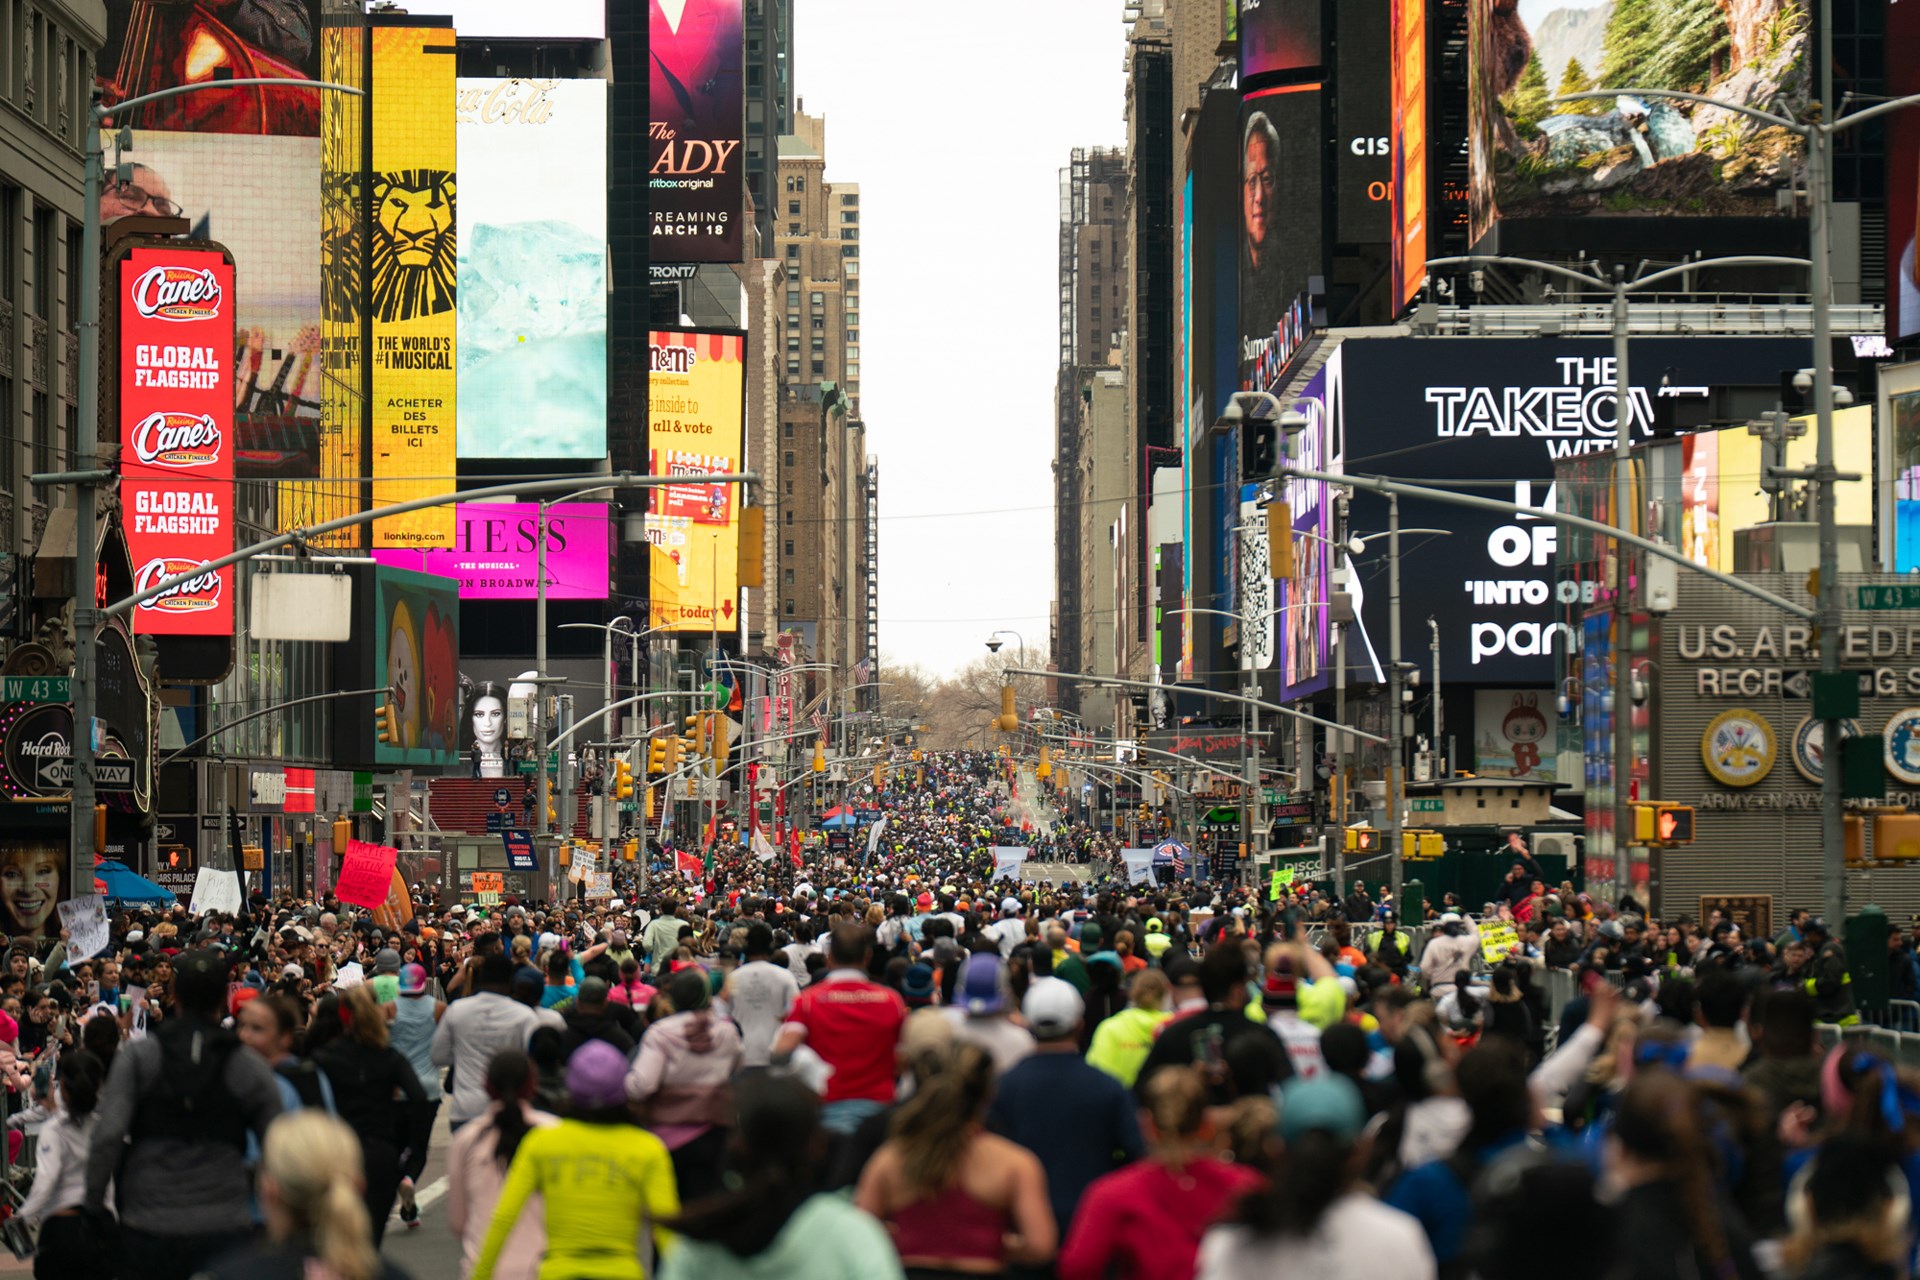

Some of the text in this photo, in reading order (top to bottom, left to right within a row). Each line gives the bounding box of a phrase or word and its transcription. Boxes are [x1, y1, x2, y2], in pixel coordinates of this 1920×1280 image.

[649, 122, 676, 140] The
[678, 178, 714, 190] original
[649, 212, 728, 222] REAMING
[706, 225, 723, 235] 18
[137, 267, 215, 315] Cane's
[377, 336, 450, 351] THE WORLD'S
[136, 345, 219, 369] GLOBAL
[375, 351, 389, 369] #1
[392, 352, 452, 369] MUSICAL
[135, 369, 219, 389] FLAGSHIP
[387, 399, 442, 408] ACHETER
[656, 395, 699, 414] inside to
[403, 412, 426, 420] DES
[391, 425, 438, 434] BILLETS
[684, 422, 713, 434] vote
[138, 413, 214, 461] Cane's
[407, 438, 422, 447] ICI
[135, 491, 219, 514] GLOBAL
[135, 515, 219, 534] FLAGSHIP
[384, 532, 445, 542] lionking.com
[1862, 588, 1876, 606] W
[1884, 588, 1903, 606] 43
[1678, 624, 1898, 659] U.S. ARED
[8, 680, 23, 698] W
[31, 680, 49, 698] 43
[21, 741, 52, 756] Hard
[96, 768, 126, 780] WAY
[1424, 801, 1435, 810] 44
[1700, 793, 1752, 808] ARMY
[1768, 793, 1824, 808] NAVY
[36, 806, 68, 814] LinkNYC
[173, 874, 196, 883] PALACE
